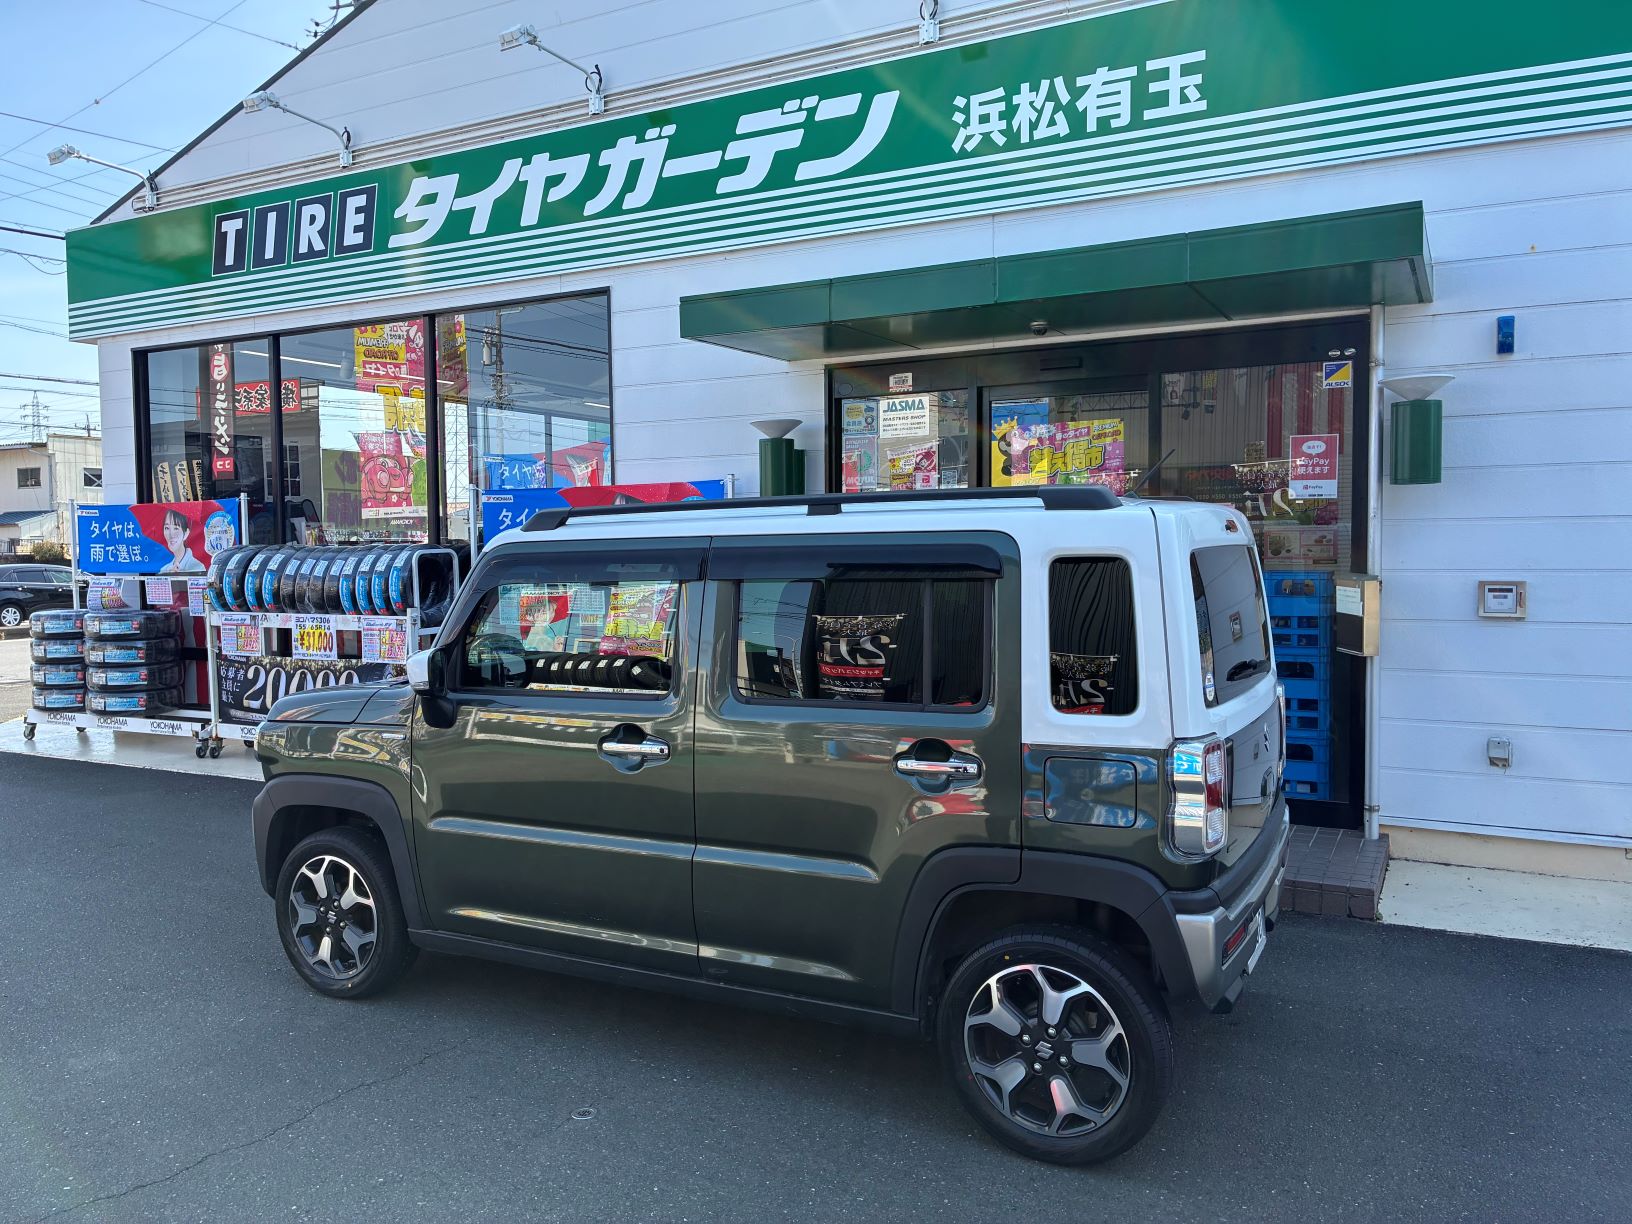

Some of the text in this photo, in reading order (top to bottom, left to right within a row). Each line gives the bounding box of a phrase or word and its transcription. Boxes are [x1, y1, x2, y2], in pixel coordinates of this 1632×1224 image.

[951, 50, 1207, 154] 浜松有玉
[388, 90, 900, 249] タイヤガーデン
[221, 194, 367, 266] TIRE
[883, 398, 926, 413] JASMA
[90, 520, 140, 539] タイヤは、
[90, 543, 149, 563] 雨で選ぼ。
[295, 616, 331, 625] ヨコハマS306
[47, 713, 77, 723] YOKOHAMA
[97, 717, 128, 728] YOKOHAMA
[149, 721, 183, 731] YOKOHAMA
